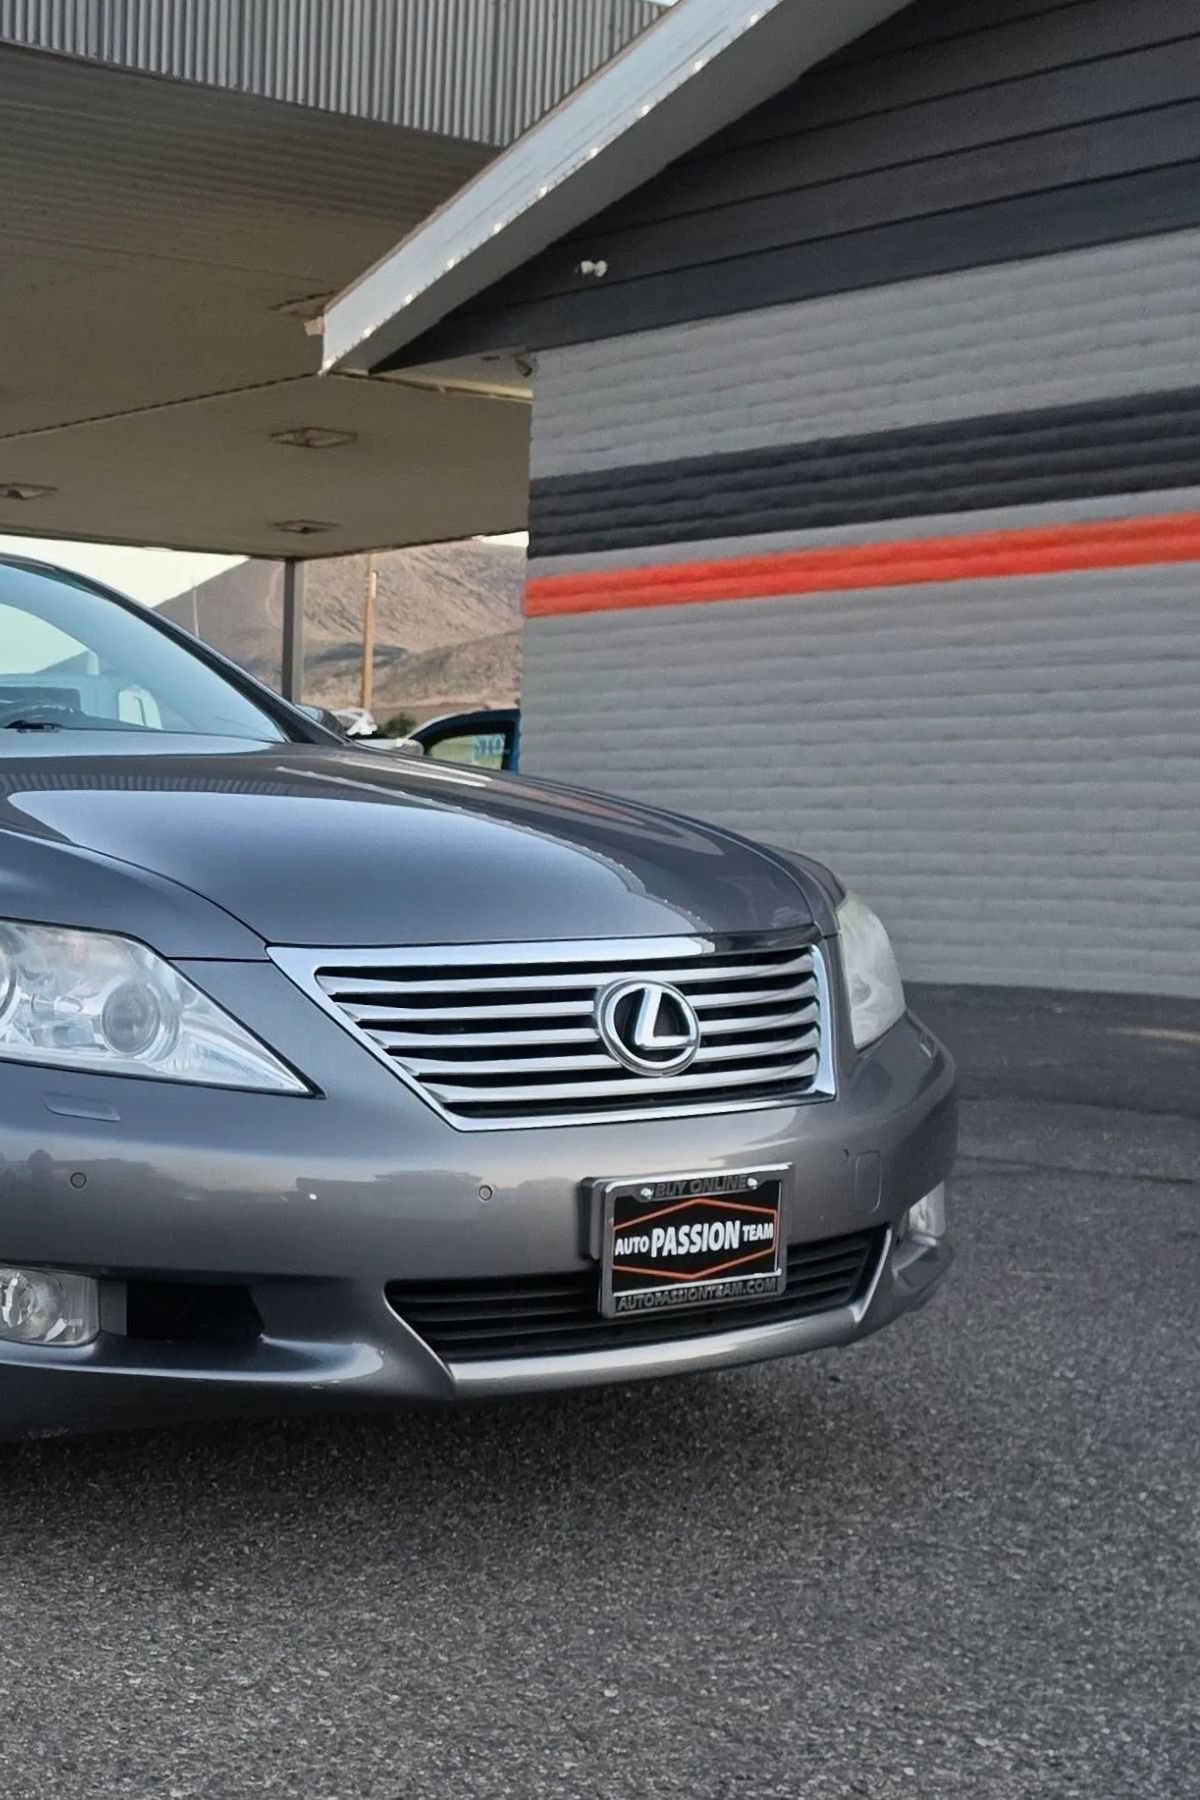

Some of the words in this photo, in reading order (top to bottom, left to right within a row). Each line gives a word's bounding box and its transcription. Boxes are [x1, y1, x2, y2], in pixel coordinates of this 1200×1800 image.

[654, 1181, 687, 1198] BUY
[689, 1174, 748, 1194] ONLINE
[614, 1235, 650, 1256] AUTO
[650, 1220, 741, 1258] PASSION
[742, 1222, 774, 1242] TEAM
